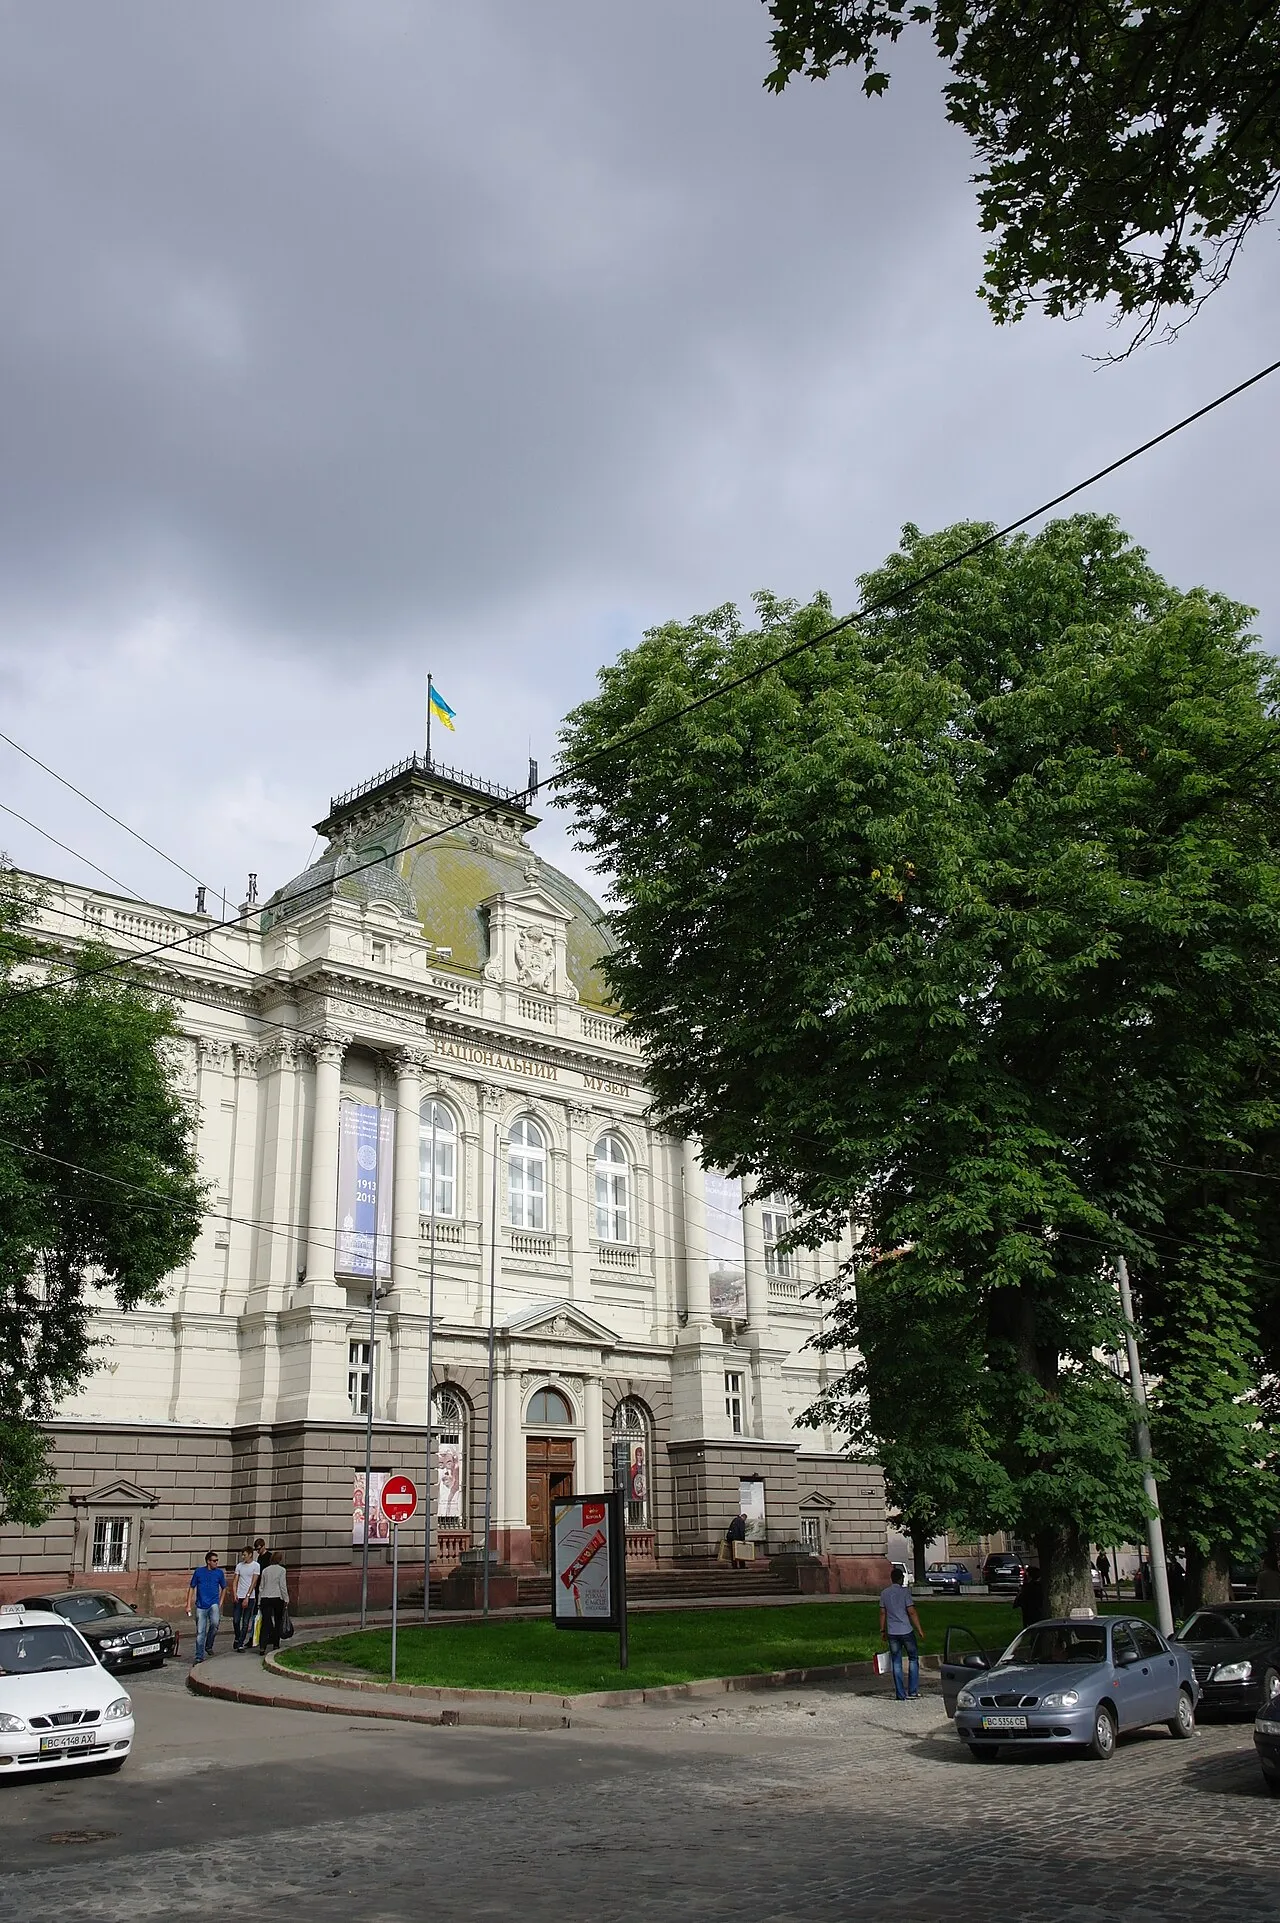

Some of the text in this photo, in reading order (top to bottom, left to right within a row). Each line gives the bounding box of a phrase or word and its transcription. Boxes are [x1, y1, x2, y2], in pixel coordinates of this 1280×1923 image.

[433, 1040, 630, 1097] НАЦІОНАЛЬНИЙ МУЗЕЙ
[357, 1179, 376, 1191] 1913
[356, 1191, 376, 1204] 2013
[987, 1717, 1025, 1726] BC 5356 CE
[48, 1734, 93, 1748] BC 4148 AX
